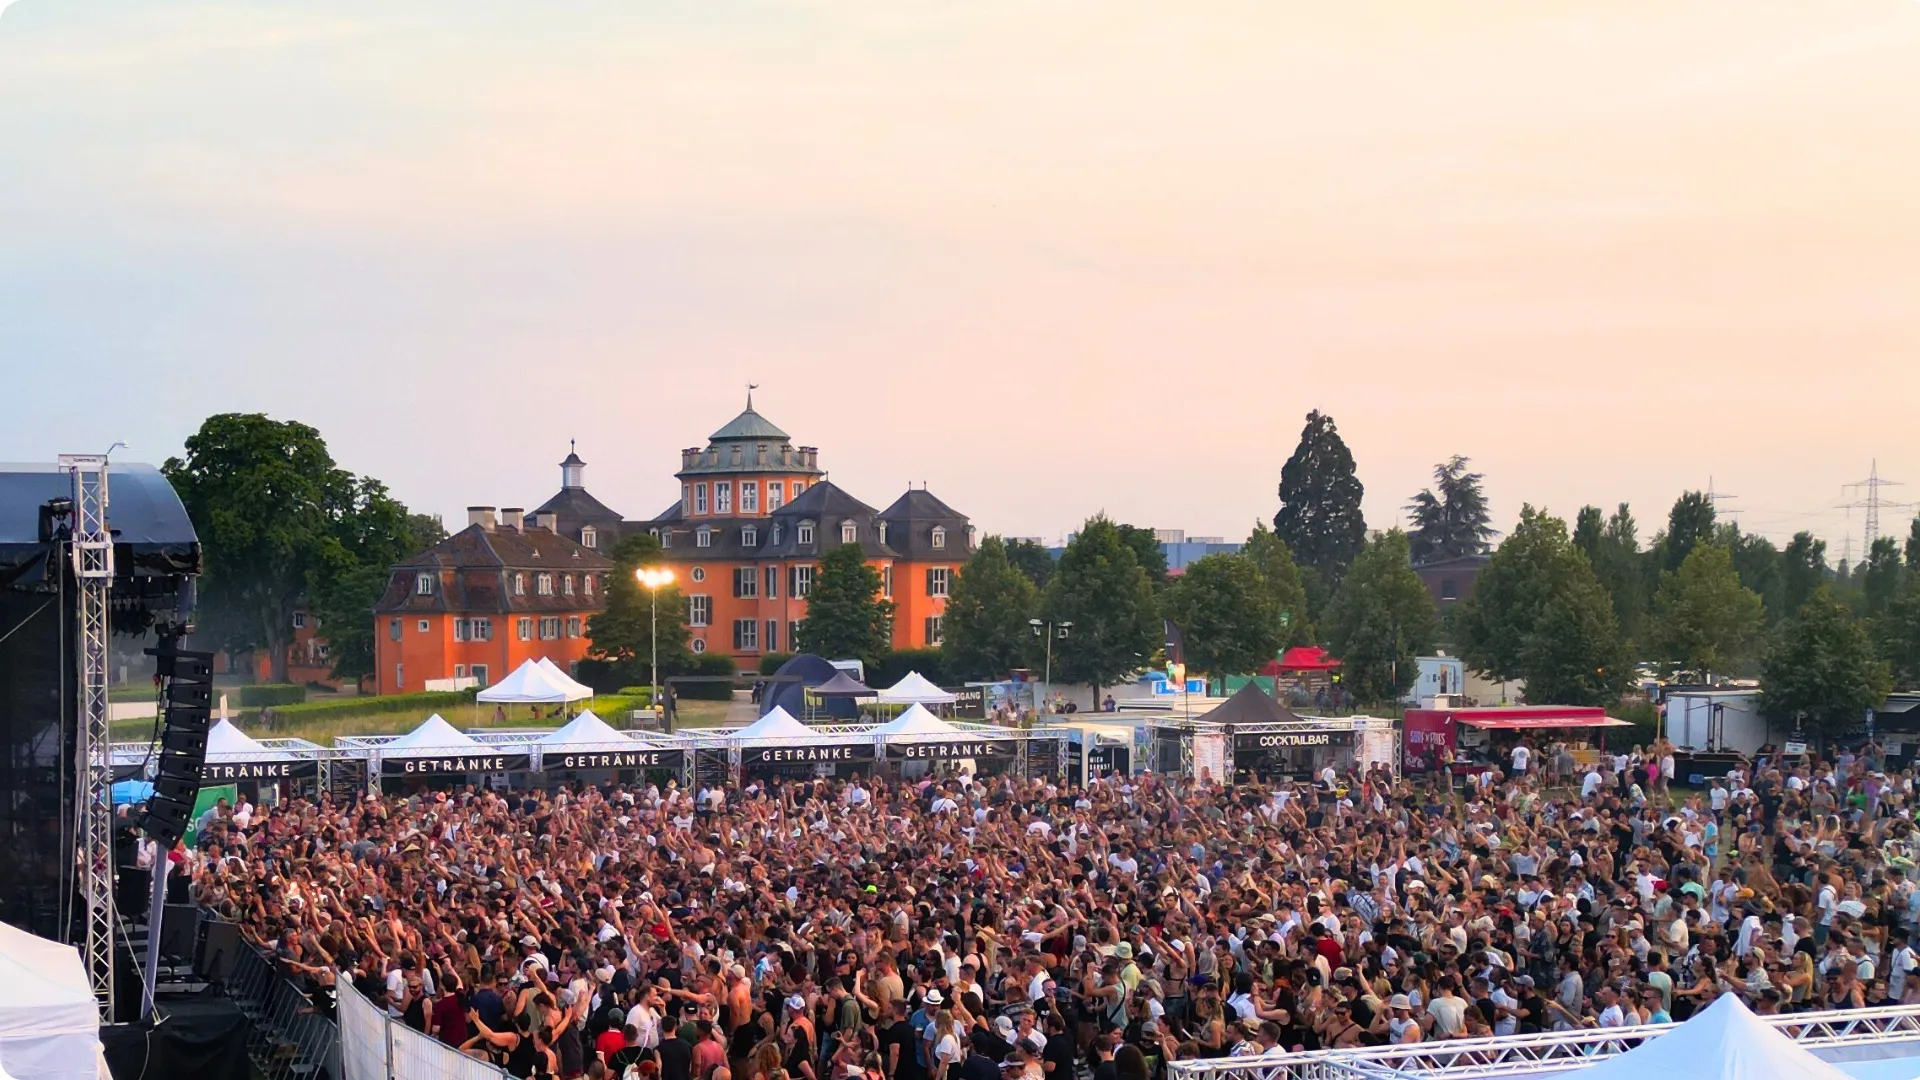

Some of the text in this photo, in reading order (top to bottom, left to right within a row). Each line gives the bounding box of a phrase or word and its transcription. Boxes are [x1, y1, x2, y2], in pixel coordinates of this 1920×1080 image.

[955, 691, 981, 701] SGANG
[1259, 734, 1329, 747] COCKTAILBAR
[762, 747, 852, 761] GETRÄNKE
[906, 743, 993, 757] GETRÄNKE
[405, 757, 504, 772] GETRÄNKE
[564, 753, 660, 768] GETRÄNKE
[201, 763, 290, 779] ETRÄNKE
